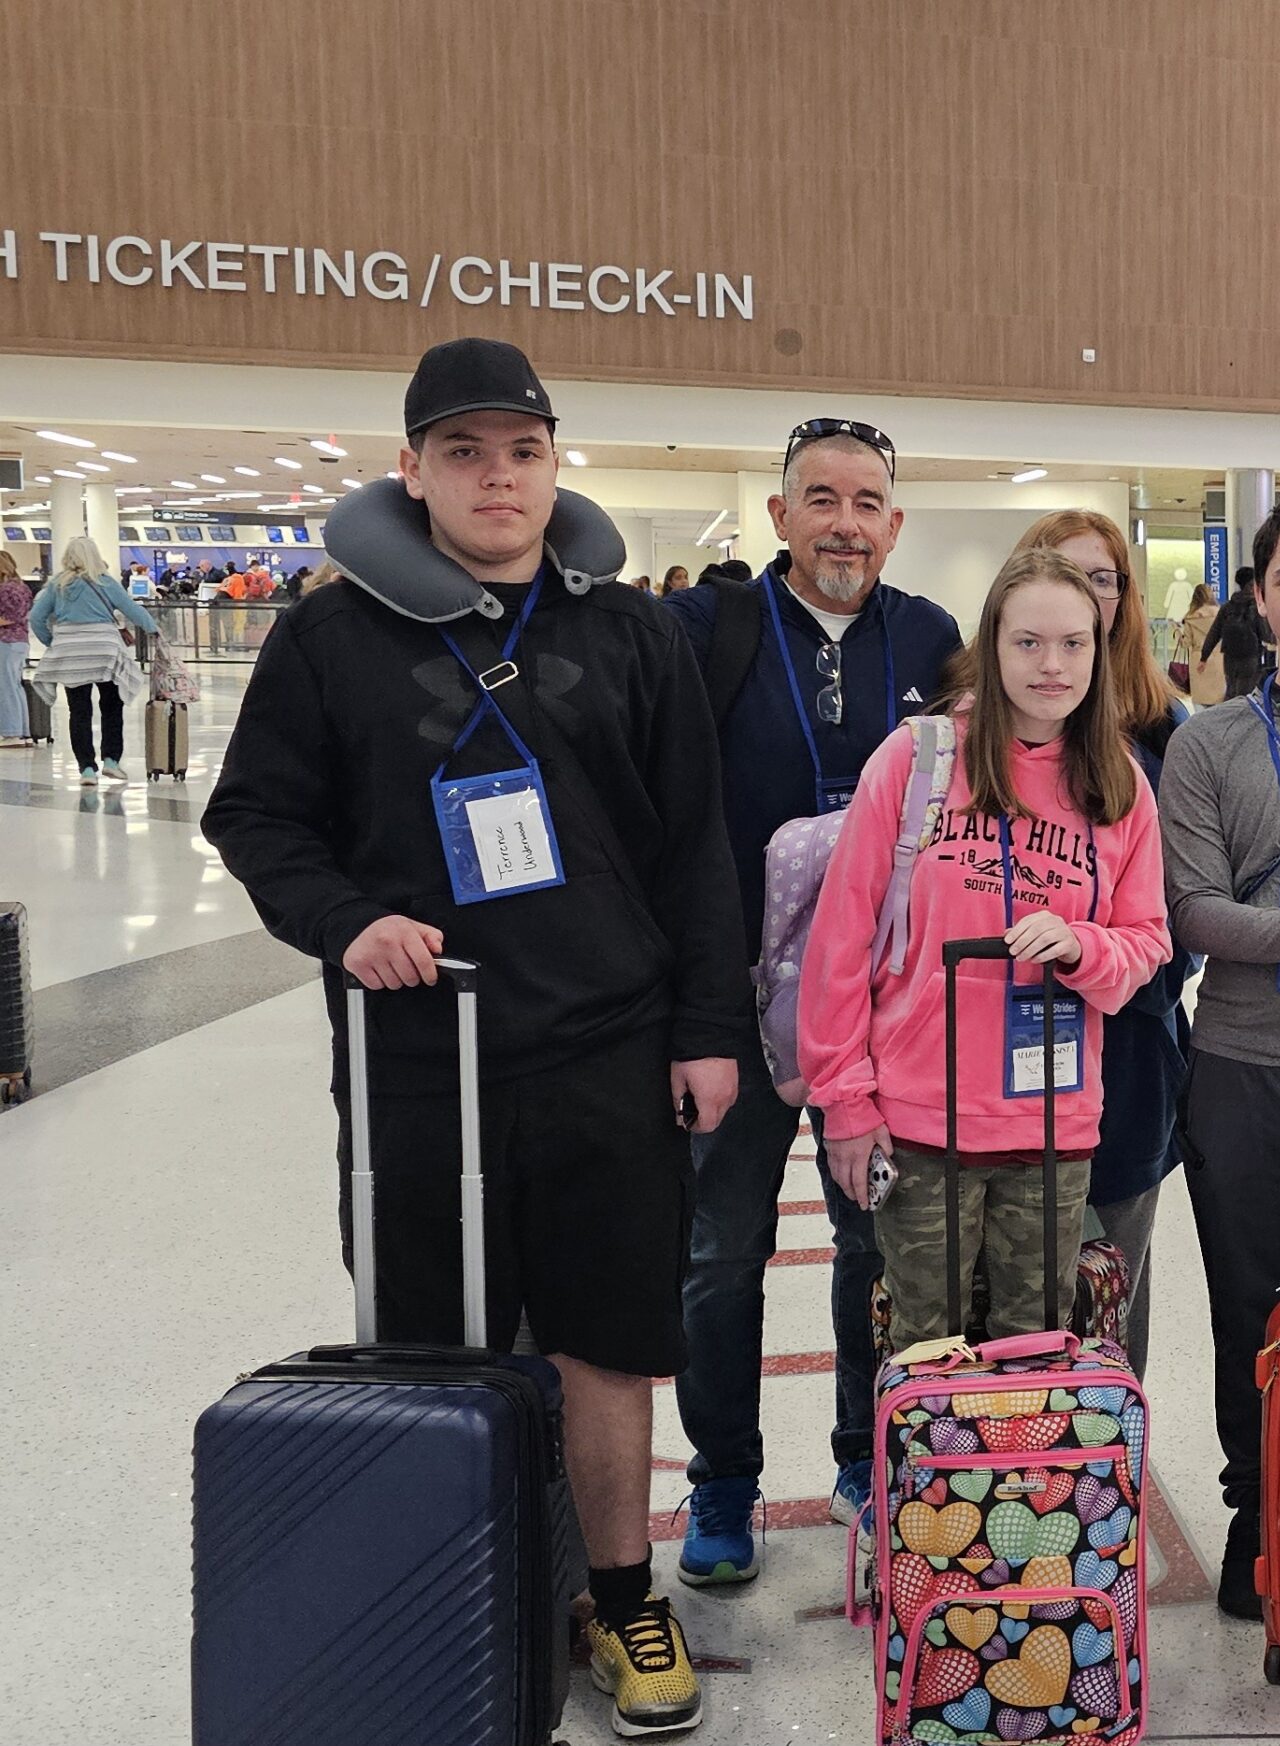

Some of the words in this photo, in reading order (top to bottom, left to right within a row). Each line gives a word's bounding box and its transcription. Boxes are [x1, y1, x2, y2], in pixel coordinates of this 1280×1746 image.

[39, 231, 409, 301] TICKETING
[495, 826, 514, 881] Terrence
[959, 849, 976, 866] 18
[1026, 819, 1098, 877] HILLS
[964, 878, 1002, 895] SOUTH
[1012, 890, 1050, 907] AKOTA
[1046, 870, 1063, 890] 89
